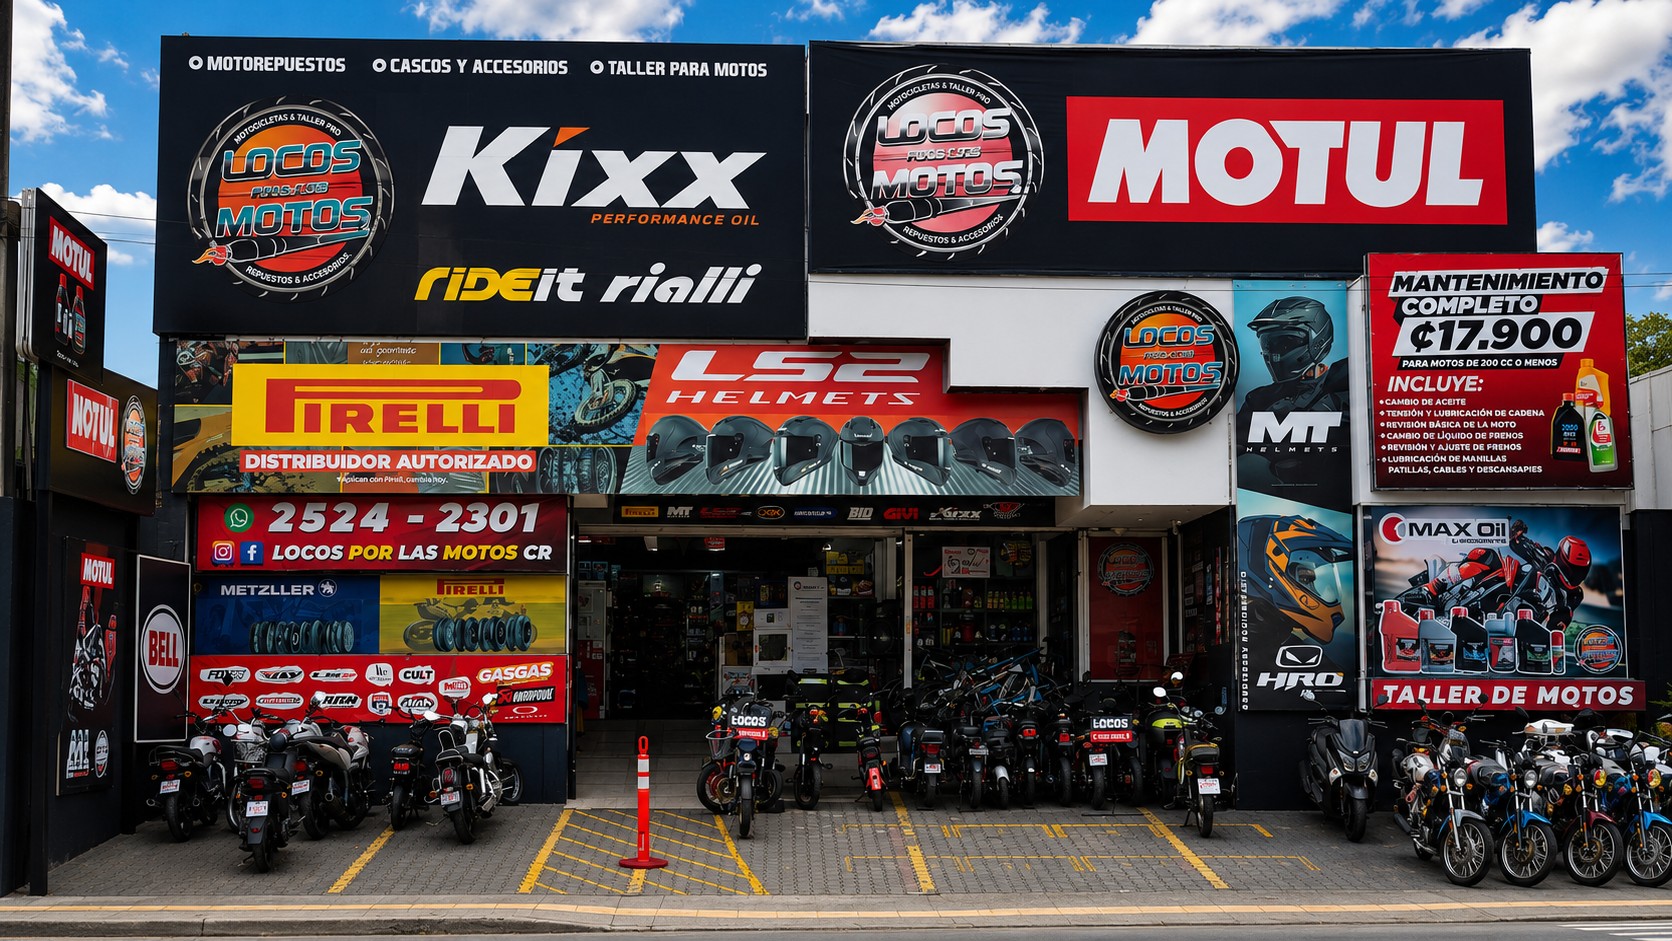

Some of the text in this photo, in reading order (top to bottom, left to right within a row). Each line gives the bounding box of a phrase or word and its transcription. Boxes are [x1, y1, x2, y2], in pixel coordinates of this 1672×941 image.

[207, 56, 346, 72] MOTOREPUESTOS
[390, 59, 568, 75] CASCOS Y ACCESORIOS
[608, 61, 767, 77] TALLER PARA MOTOS
[877, 108, 1012, 146] LOCOS
[222, 139, 362, 182] LOCOS
[422, 126, 768, 210] Kixx
[1088, 118, 1484, 208] MOTUL
[871, 160, 1024, 200] MOTOS
[216, 196, 374, 238] MOTOS
[590, 214, 760, 226] PERFORMANCE OIL
[51, 225, 92, 284] MOTUL
[246, 265, 293, 284] REPUESTOS
[1392, 272, 1604, 292] MANTENIMIENTO
[1402, 295, 1538, 316] COMPLETO
[1123, 325, 1214, 348] LOCOS
[671, 350, 930, 383] LS2
[1402, 358, 1558, 368] PARA MOTOS DE 200 CC O MENOS
[1118, 361, 1223, 385] MOTOS
[1387, 376, 1484, 392] INCLUYE:
[265, 378, 522, 434] PIRELLI
[666, 390, 920, 405] HELMETS
[1434, 408, 1492, 417] LUBRICACIÓN
[1248, 411, 1342, 443] MT
[1429, 420, 1461, 428] BÁSICA
[245, 454, 533, 470] DISTRIBUIDOR AUTORIZADO
[1388, 454, 1446, 462] LUBRICACIÓN
[1388, 466, 1431, 474] PATILLAS,
[268, 502, 540, 533] 2524 - 2301
[883, 507, 919, 520] GIVI
[1409, 523, 1506, 537] MAX Oil
[272, 545, 552, 560] LOCOS POR LAS MOTOS CR
[83, 558, 112, 585] MOTUL
[220, 584, 314, 596] METZLLER
[437, 579, 504, 595] PIRELLI
[148, 630, 179, 667] BELL
[403, 670, 433, 679] CULT
[479, 663, 551, 682] GASGAS
[1382, 685, 1482, 705] TALLER
[1491, 686, 1527, 705] DE
[731, 715, 766, 727] LOCOS
[1093, 718, 1128, 728] LOCOS
